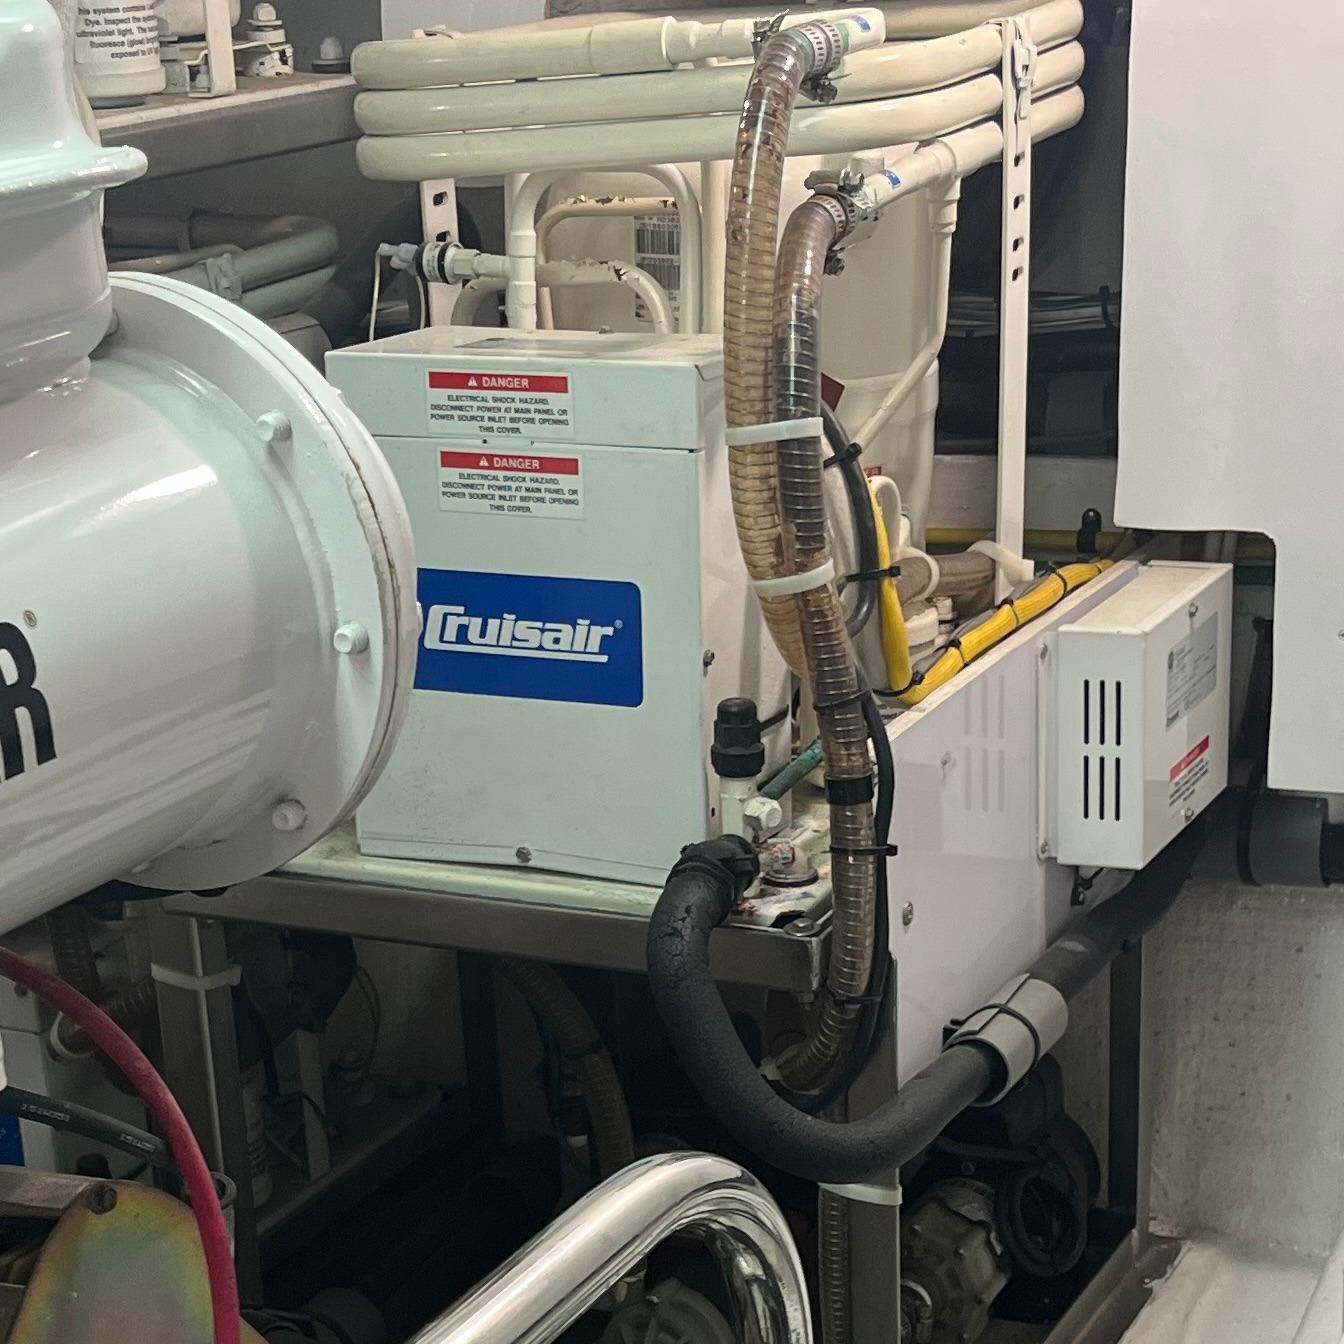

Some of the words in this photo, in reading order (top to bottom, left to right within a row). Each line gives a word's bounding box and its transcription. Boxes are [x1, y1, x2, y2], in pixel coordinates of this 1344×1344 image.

[84, 18, 102, 28] Dye.
[482, 376, 530, 389] DANGER
[447, 394, 490, 403] ELECTRICAL
[491, 396, 516, 404] SHOCK
[430, 403, 474, 412] DISCONNECT
[476, 405, 502, 413] POWER
[513, 407, 532, 415] MAIN
[533, 408, 555, 416] PANEL
[430, 413, 455, 421] POWER
[457, 414, 486, 422] SOURCE
[508, 416, 536, 425] BEFORE
[538, 418, 569, 426] OPENING
[478, 425, 495, 433] THIS
[493, 456, 541, 470] DANGER
[458, 472, 501, 482] ELECTRICAL
[502, 475, 527, 483] SHOCK
[441, 481, 485, 491] DISCONNECT
[487, 484, 513, 492] POWER
[524, 486, 542, 494] MAIN
[543, 487, 566, 496] PANEL
[441, 491, 467, 499] POWER
[467, 492, 496, 501] SOURCE
[498, 494, 517, 502] INLET
[519, 495, 547, 504] BEFORE
[548, 497, 580, 506] OPENING
[489, 504, 506, 512] THIS
[424, 604, 615, 662] Cruisair
